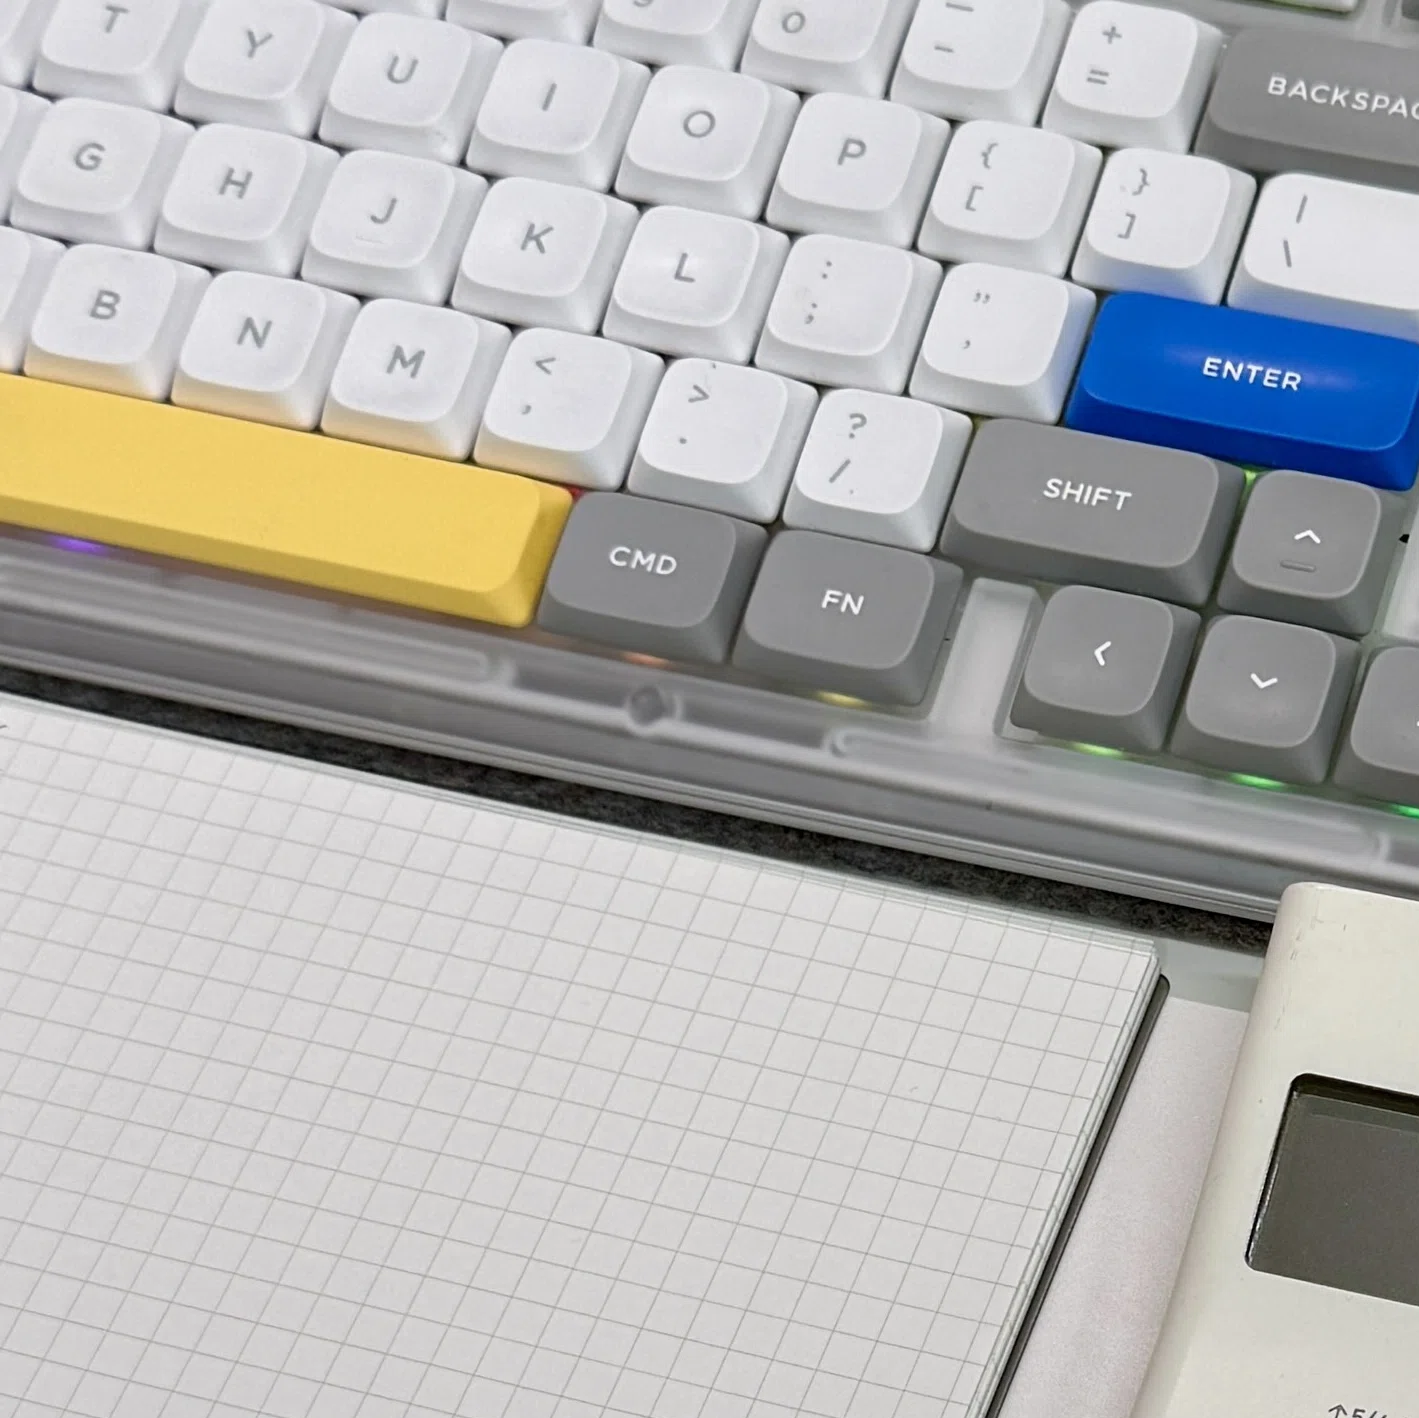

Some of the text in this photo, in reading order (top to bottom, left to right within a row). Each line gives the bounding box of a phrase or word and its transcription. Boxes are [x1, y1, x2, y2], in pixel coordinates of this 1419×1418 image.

[104, 3, 129, 34] T
[246, 29, 273, 59] Y
[385, 55, 419, 85] U
[541, 82, 557, 112] I
[682, 109, 716, 139] O
[73, 141, 106, 172] G
[837, 137, 867, 166] P
[218, 167, 253, 200] H
[369, 197, 398, 225] J
[520, 222, 554, 255] K
[673, 252, 696, 284] L
[88, 289, 121, 321] B
[236, 316, 273, 349] N
[386, 345, 426, 379] M
[1202, 356, 1302, 391] ENTER
[1043, 477, 1133, 511] SHIFT
[608, 545, 677, 575] CMD
[821, 589, 865, 615] FN
